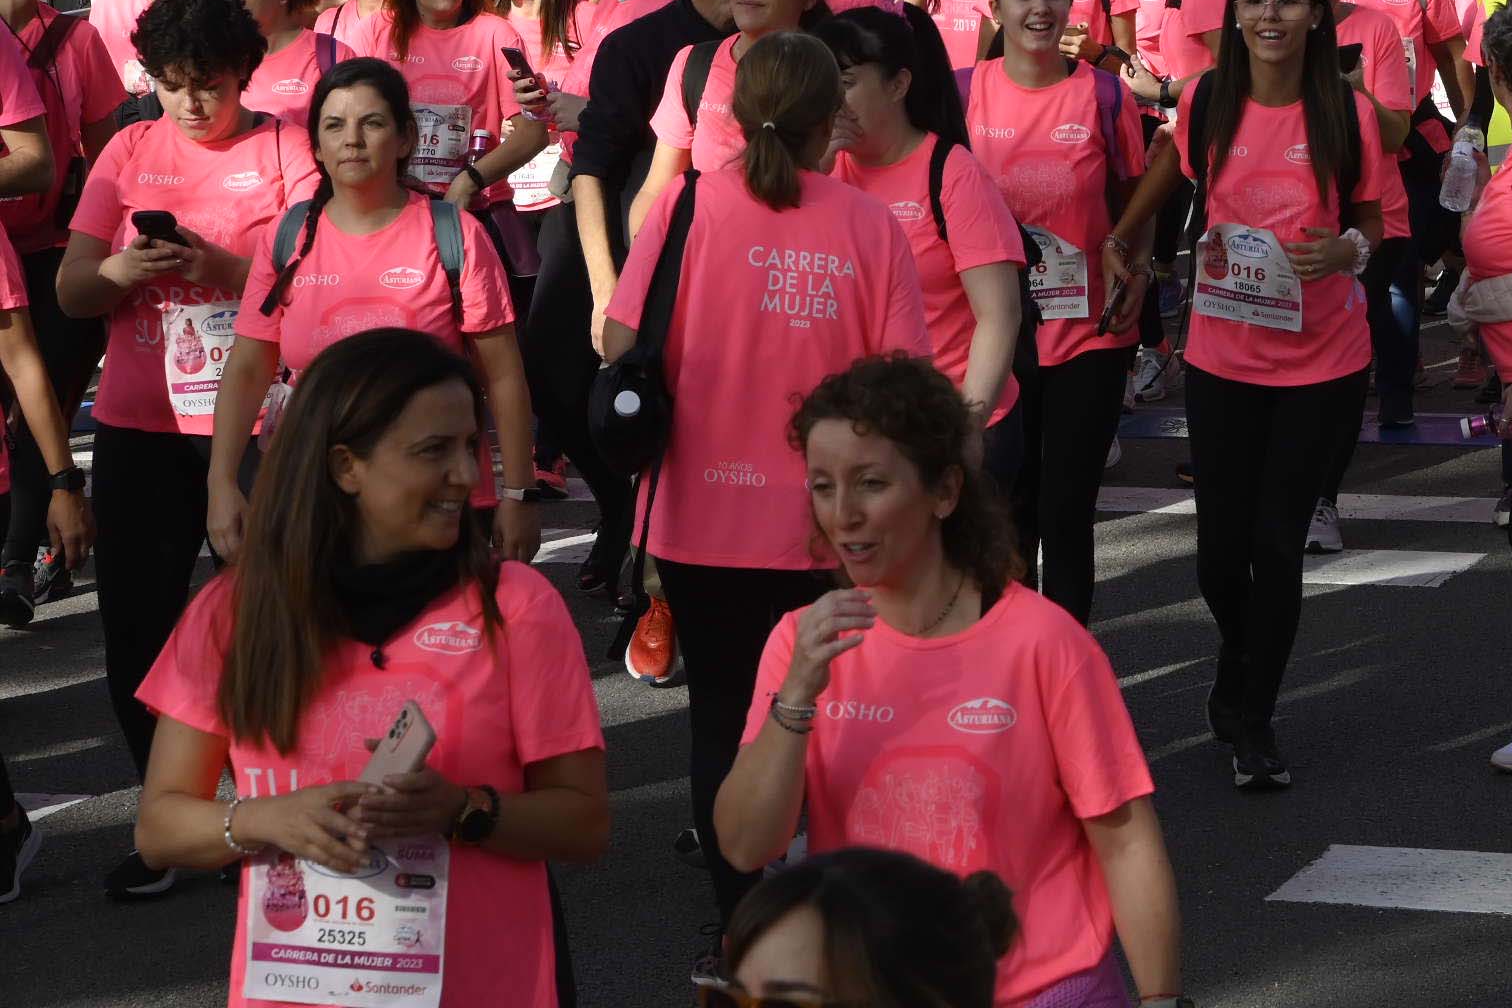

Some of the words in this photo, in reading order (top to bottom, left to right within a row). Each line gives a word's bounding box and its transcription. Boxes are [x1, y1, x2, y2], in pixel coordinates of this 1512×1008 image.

[953, 18, 977, 32] 2019
[421, 133, 440, 146] 16
[975, 124, 1015, 139] OYSHO
[138, 173, 184, 185] OYSHO
[748, 245, 856, 280] CARRERA
[1231, 262, 1266, 282] 016
[768, 270, 798, 293] DE
[807, 276, 836, 297] LA
[760, 293, 838, 320] MUJER
[1203, 299, 1236, 313] OYSHO
[135, 319, 162, 345] SU
[789, 318, 810, 329] 2023
[184, 382, 219, 391] CARRERA
[704, 467, 766, 488] OYSHO
[312, 893, 376, 923] 016
[316, 927, 367, 947] 25325
[271, 948, 318, 964] CARRERA
[320, 952, 335, 964] DE
[336, 953, 352, 966] LA
[353, 954, 393, 969] MUJER
[264, 972, 320, 991] OYSHO
[364, 980, 427, 997] Santander
